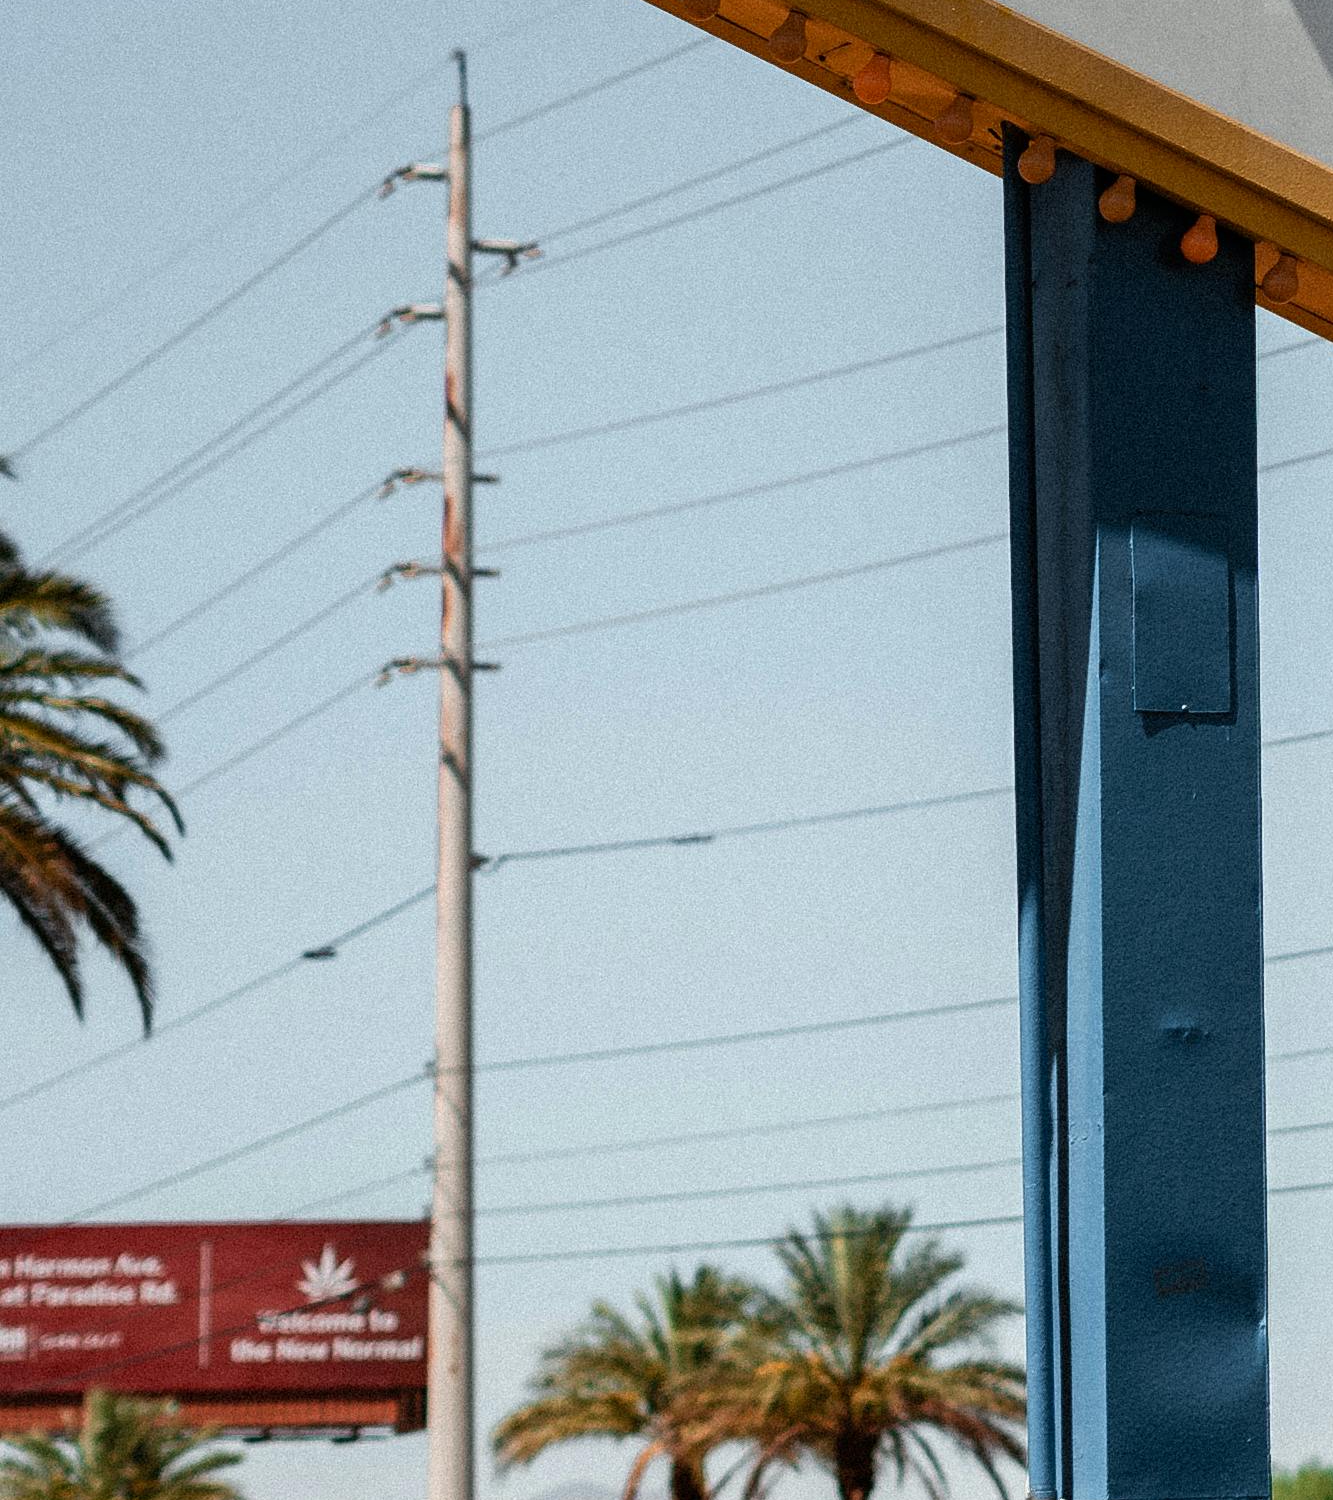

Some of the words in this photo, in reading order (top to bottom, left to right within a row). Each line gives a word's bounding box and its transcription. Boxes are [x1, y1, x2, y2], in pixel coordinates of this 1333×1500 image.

[256, 1310, 367, 1335] Welcome
[369, 1308, 400, 1332] to
[230, 1337, 274, 1364] the
[275, 1337, 329, 1363] New
[331, 1336, 424, 1363] Normal
